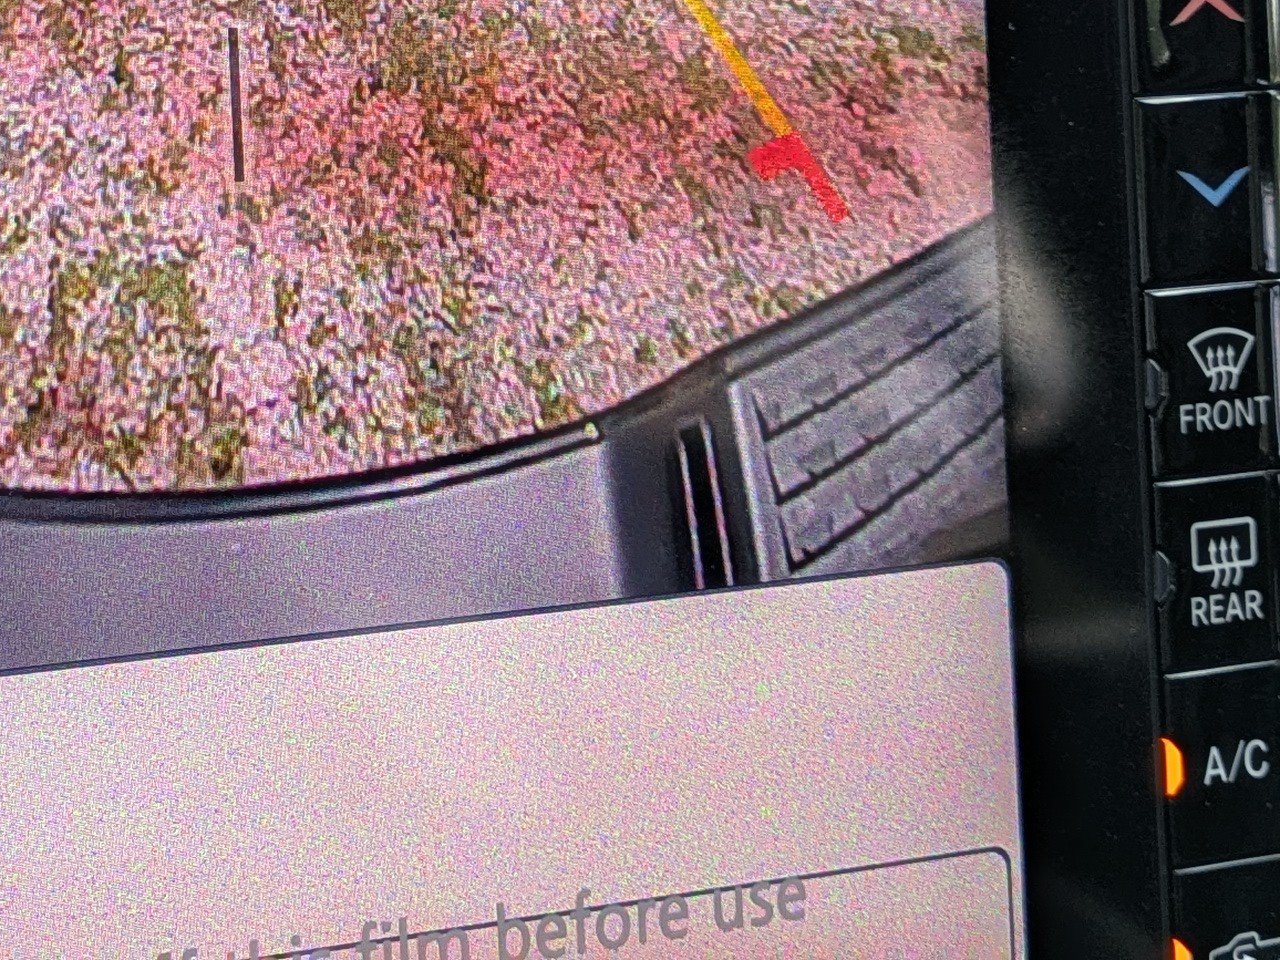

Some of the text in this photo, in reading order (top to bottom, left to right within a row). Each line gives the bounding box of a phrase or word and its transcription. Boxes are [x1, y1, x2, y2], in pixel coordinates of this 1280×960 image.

[1178, 394, 1272, 435] FRONT
[1189, 589, 1265, 627] REAR
[1203, 738, 1270, 786] A/C
[495, 887, 690, 960] before
[712, 875, 807, 933] use
